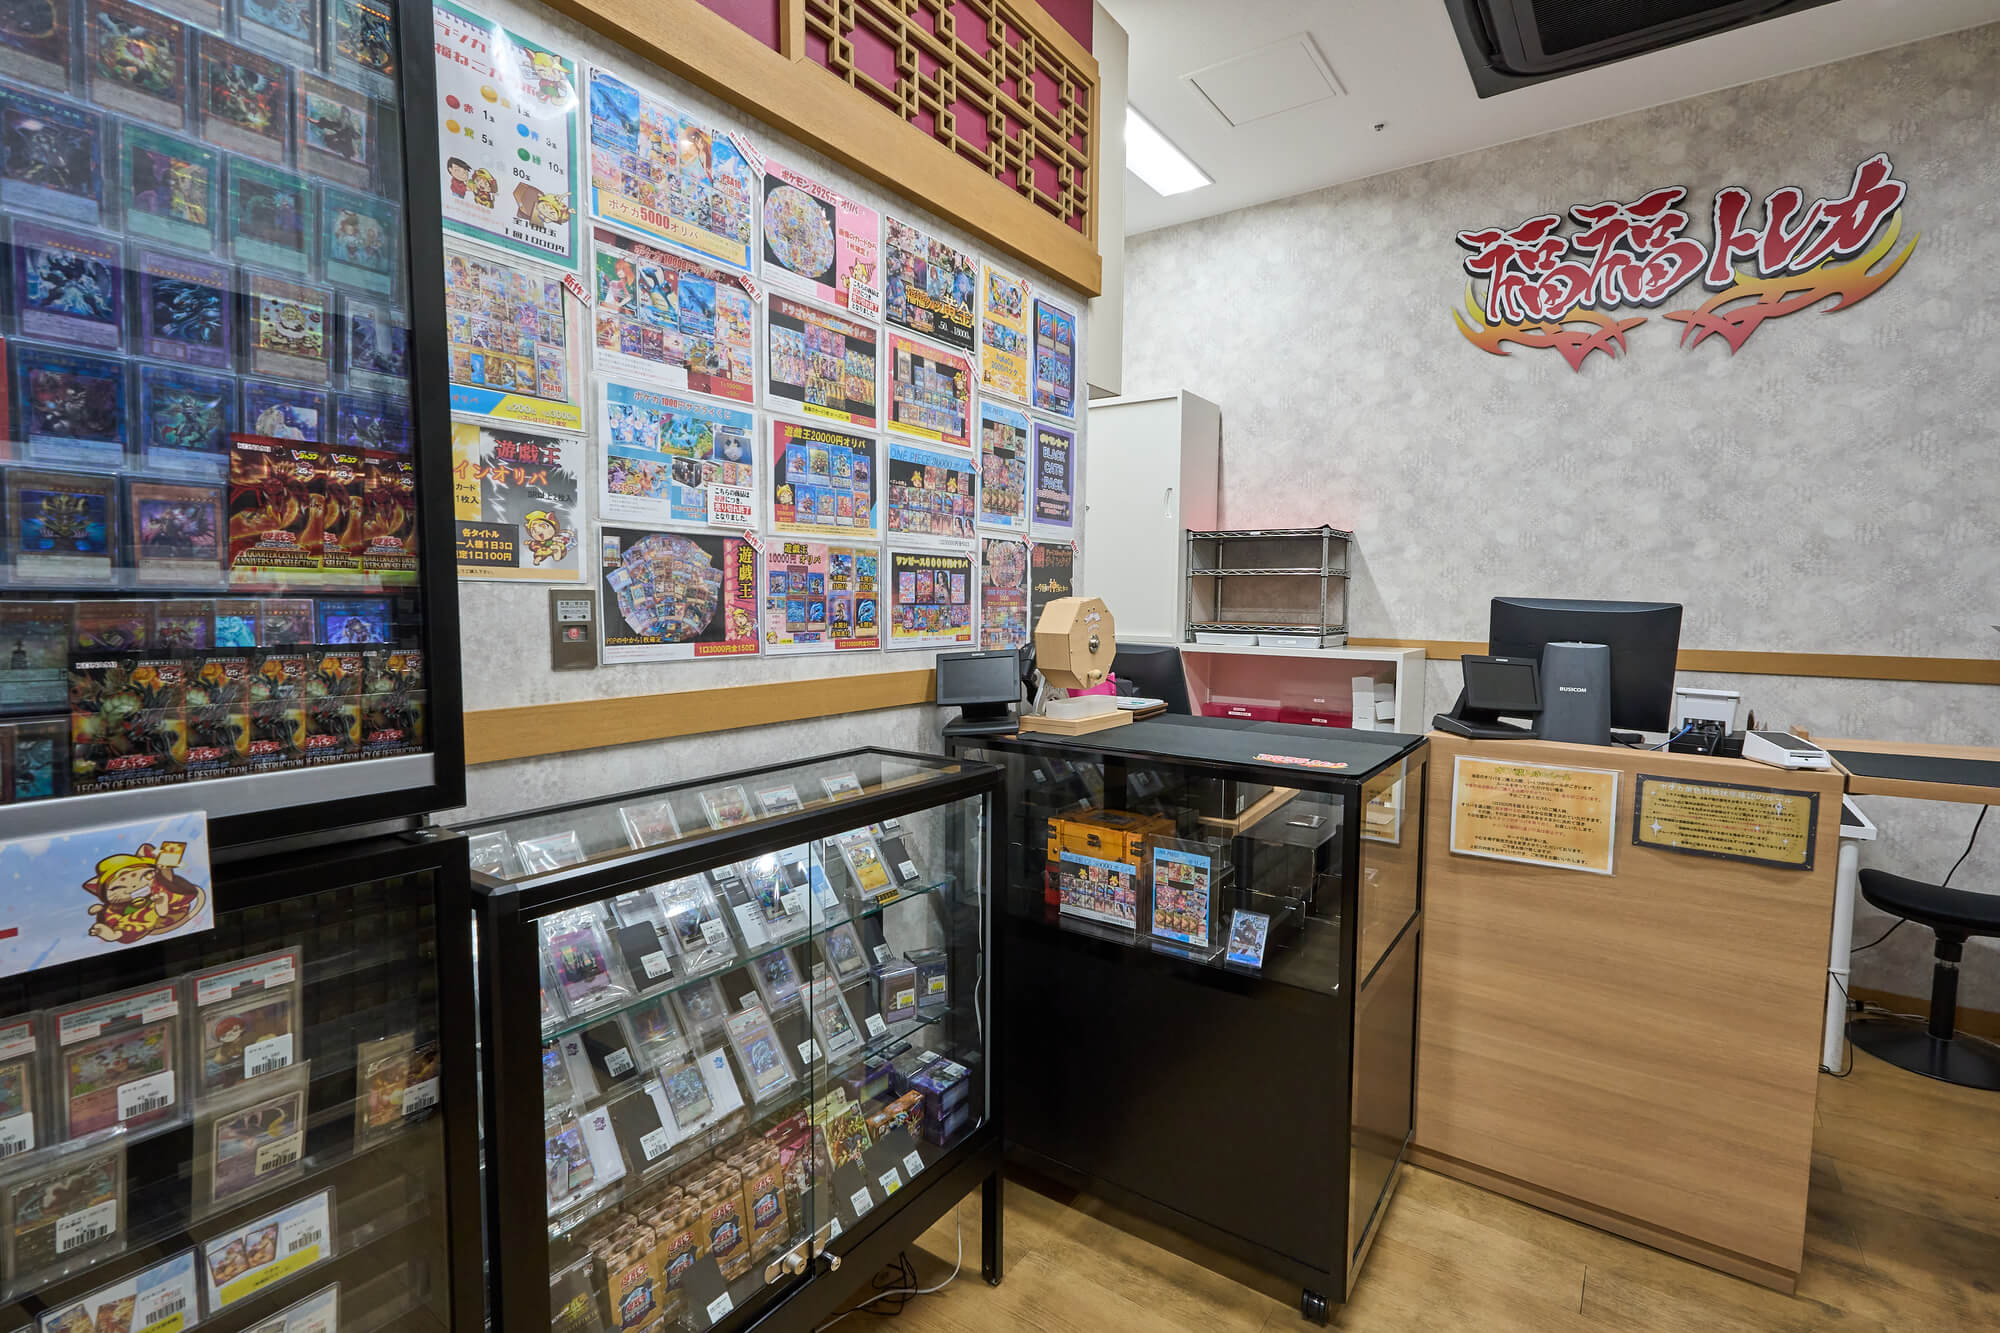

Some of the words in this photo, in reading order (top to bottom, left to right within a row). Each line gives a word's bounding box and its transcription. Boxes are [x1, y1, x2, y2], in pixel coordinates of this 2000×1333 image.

[1456, 152, 1907, 326] 福福トレカ
[495, 439, 562, 468] 遊戯王
[455, 483, 477, 491] カード
[461, 528, 500, 539] 各タイトル
[737, 546, 753, 599] 遊戯王
[1559, 686, 1588, 695] BUSICOM
[126, 774, 185, 788] DESTRUCTION
